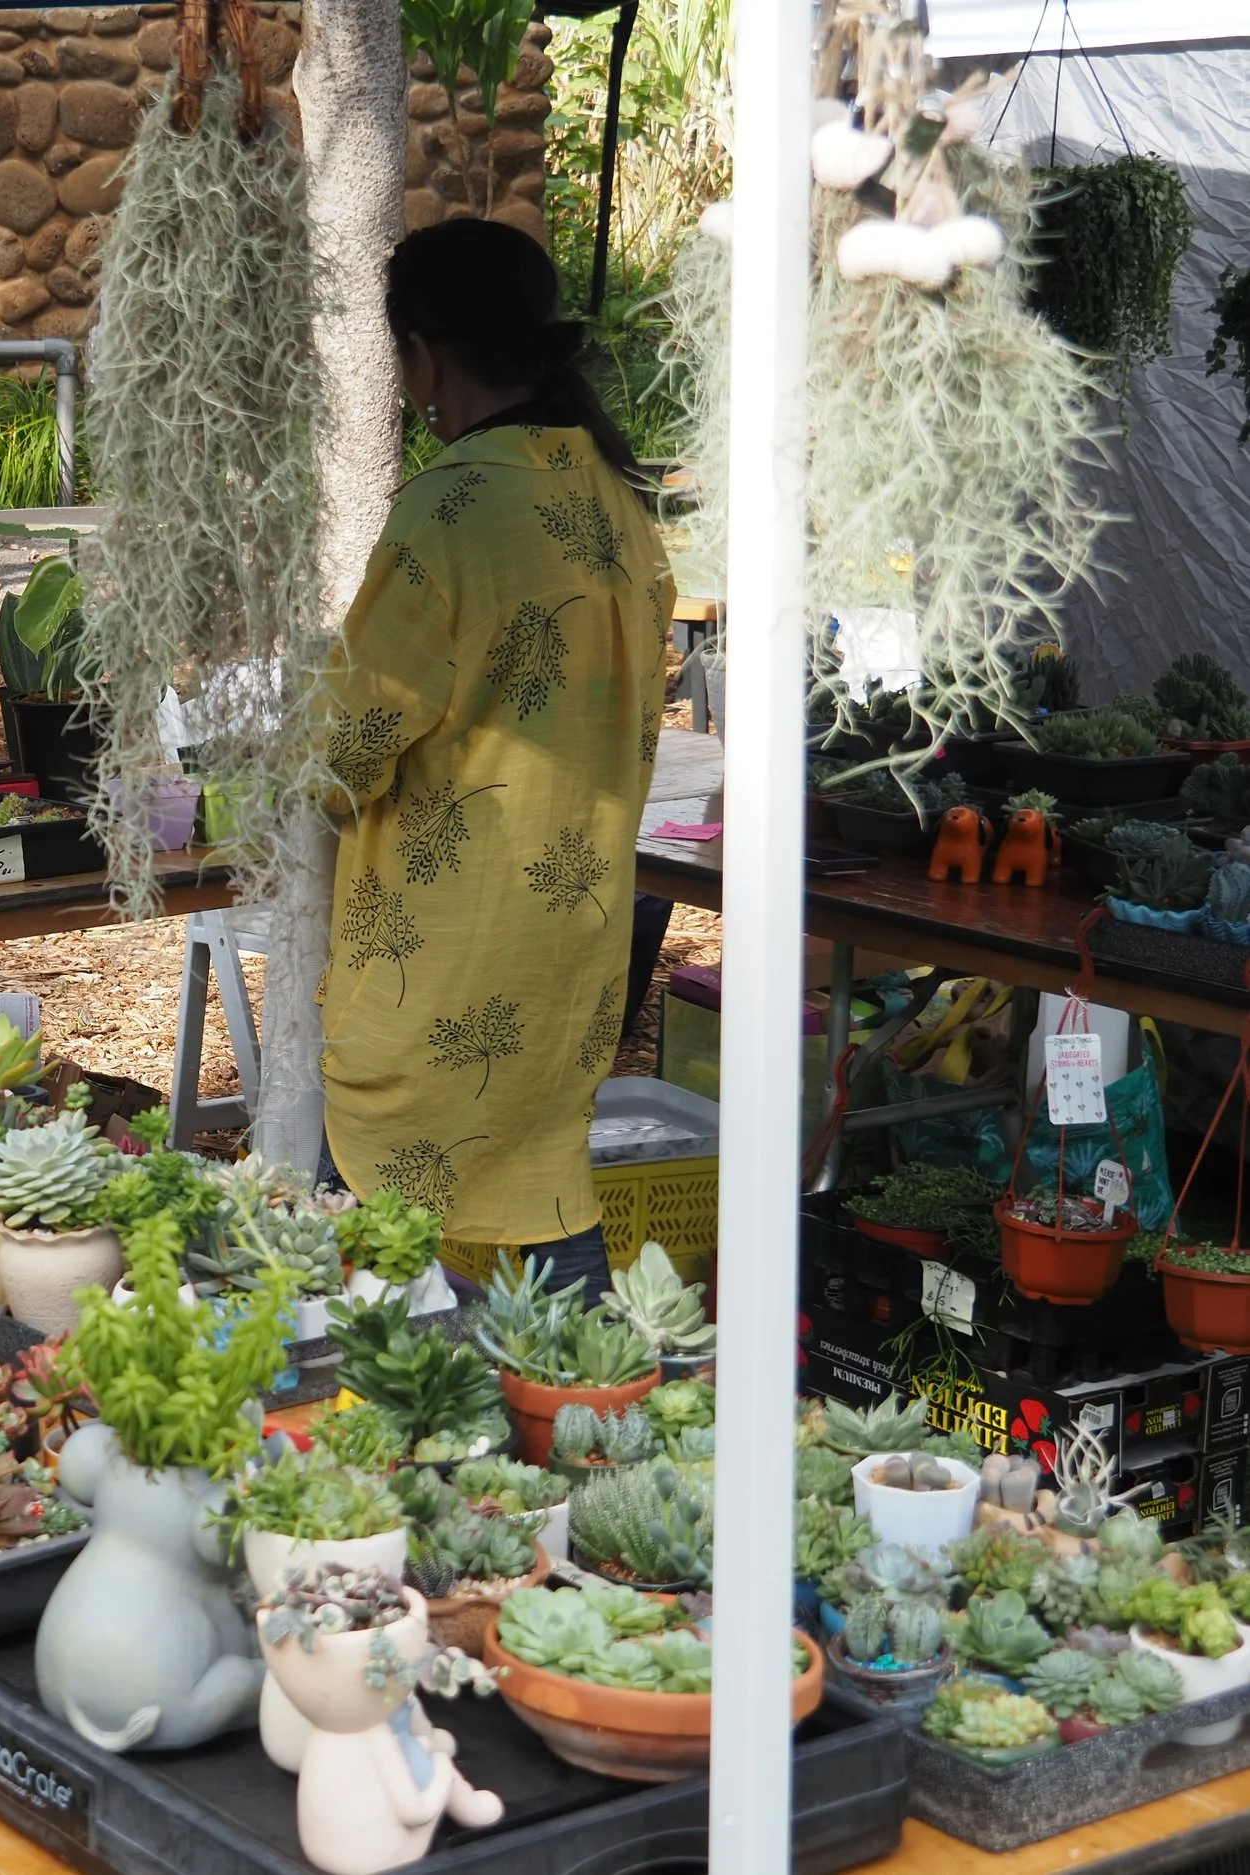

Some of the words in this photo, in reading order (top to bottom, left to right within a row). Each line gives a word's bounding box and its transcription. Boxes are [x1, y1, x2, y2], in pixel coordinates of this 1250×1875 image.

[819, 1340, 871, 1368] strawberries
[832, 1366, 882, 1395] PREMIUM
[909, 1375, 1008, 1431] EDITION
[910, 1399, 1008, 1456] LIMITE
[1139, 1501, 1175, 1518] EDITION
